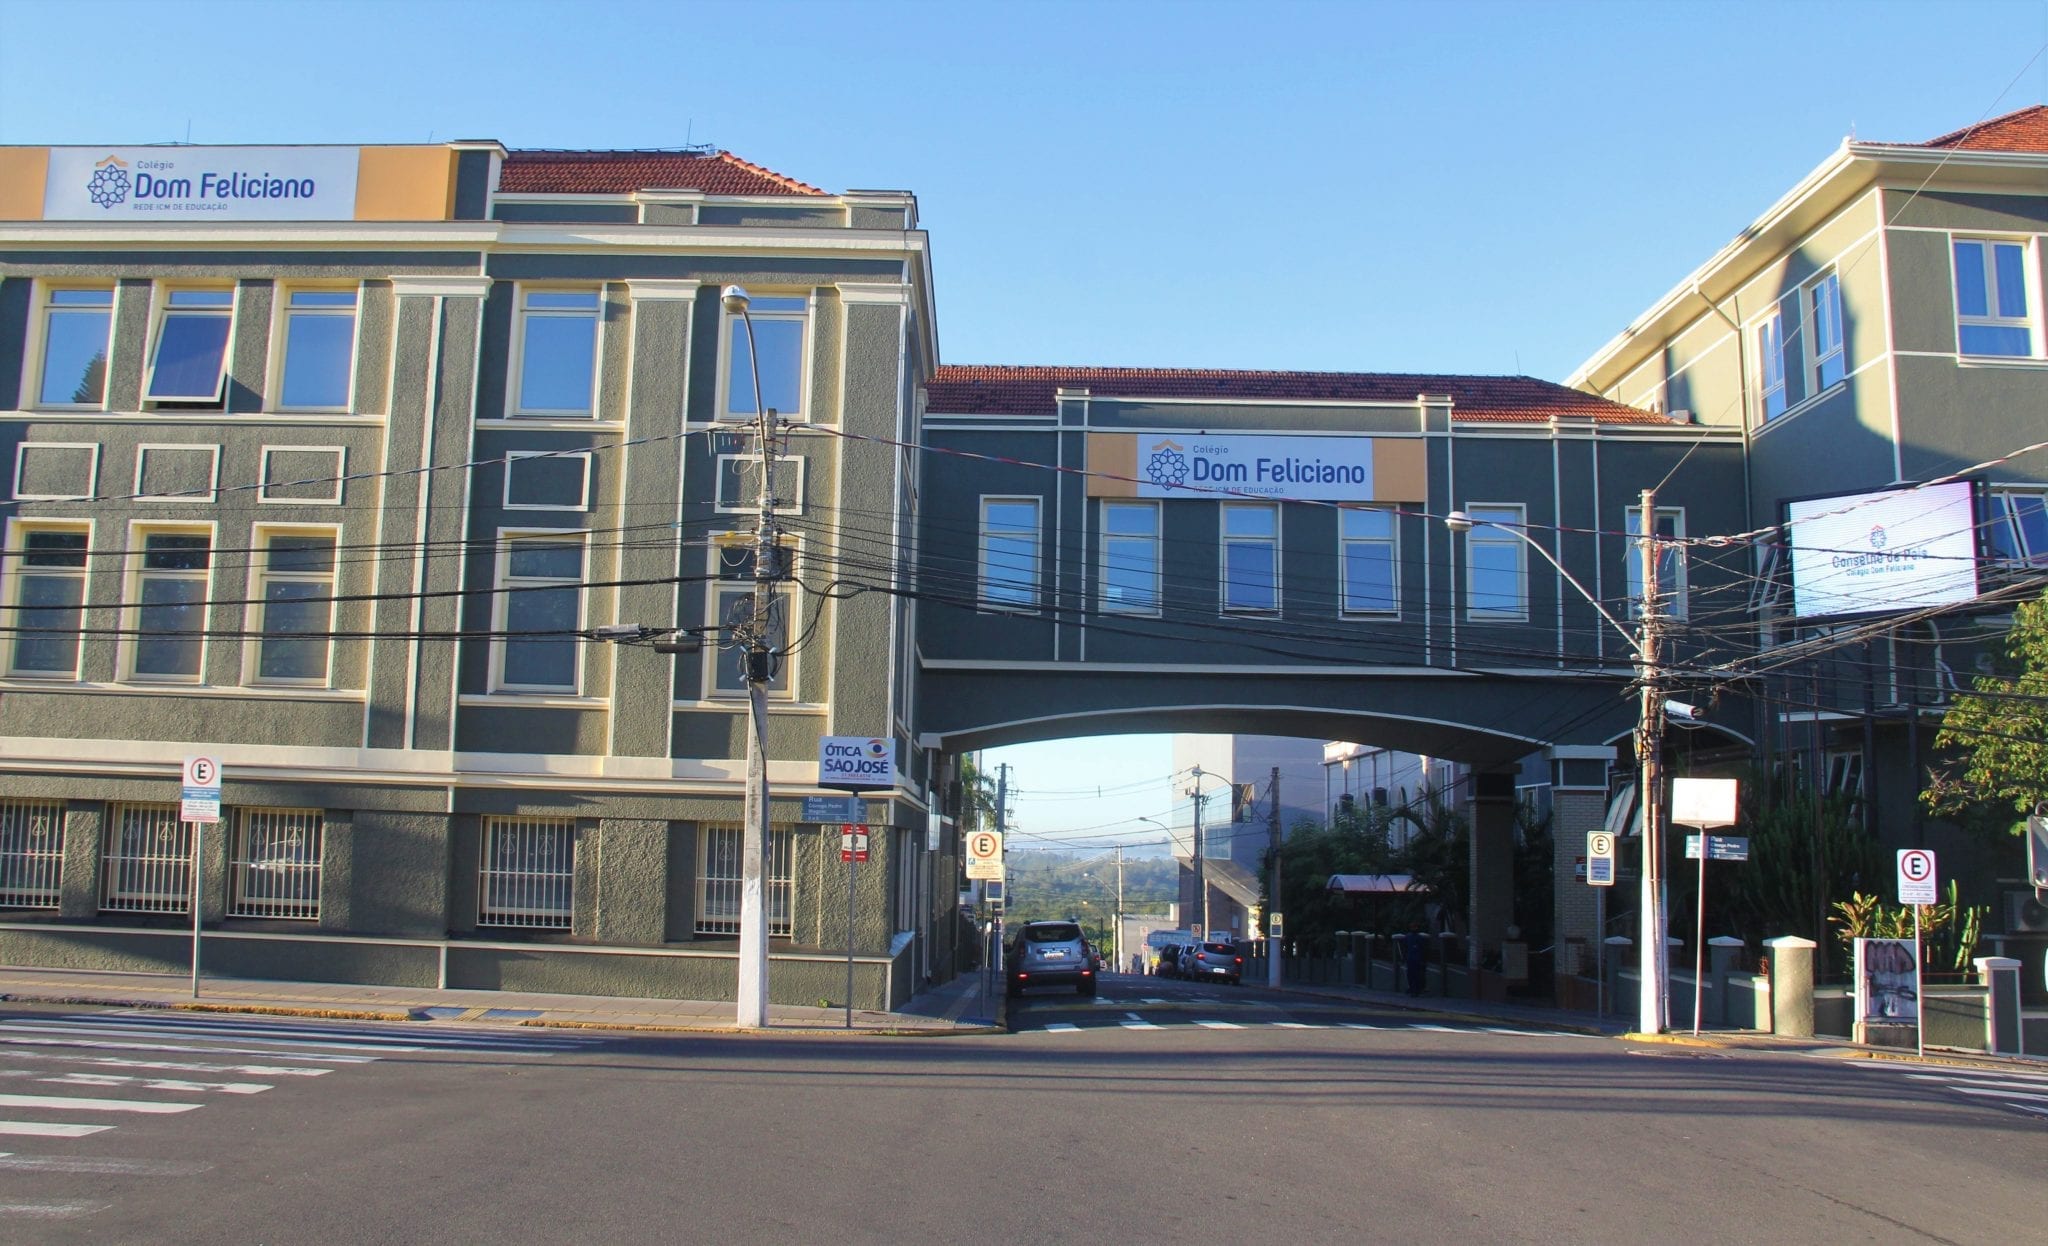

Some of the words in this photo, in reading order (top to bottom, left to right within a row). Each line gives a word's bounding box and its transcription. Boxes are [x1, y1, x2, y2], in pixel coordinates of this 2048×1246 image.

[137, 160, 174, 171] Colégio
[135, 172, 191, 199] Dom
[200, 172, 315, 199] Feliciano
[133, 203, 154, 211] REDE
[156, 203, 171, 211] ICM
[173, 203, 183, 211] DE
[185, 202, 228, 212] EDUCAÇÃO
[1193, 445, 1229, 456] Colégio
[1193, 457, 1247, 482] Dom
[1256, 457, 1365, 484] Feliciano
[1243, 486, 1284, 495] EDUCAÇÃO
[825, 742, 862, 757] ÓTICA
[198, 763, 207, 779] E
[854, 759, 889, 774] JOSÉ
[979, 838, 988, 852] E
[1597, 839, 1604, 851] E
[1911, 857, 1922, 875] E
